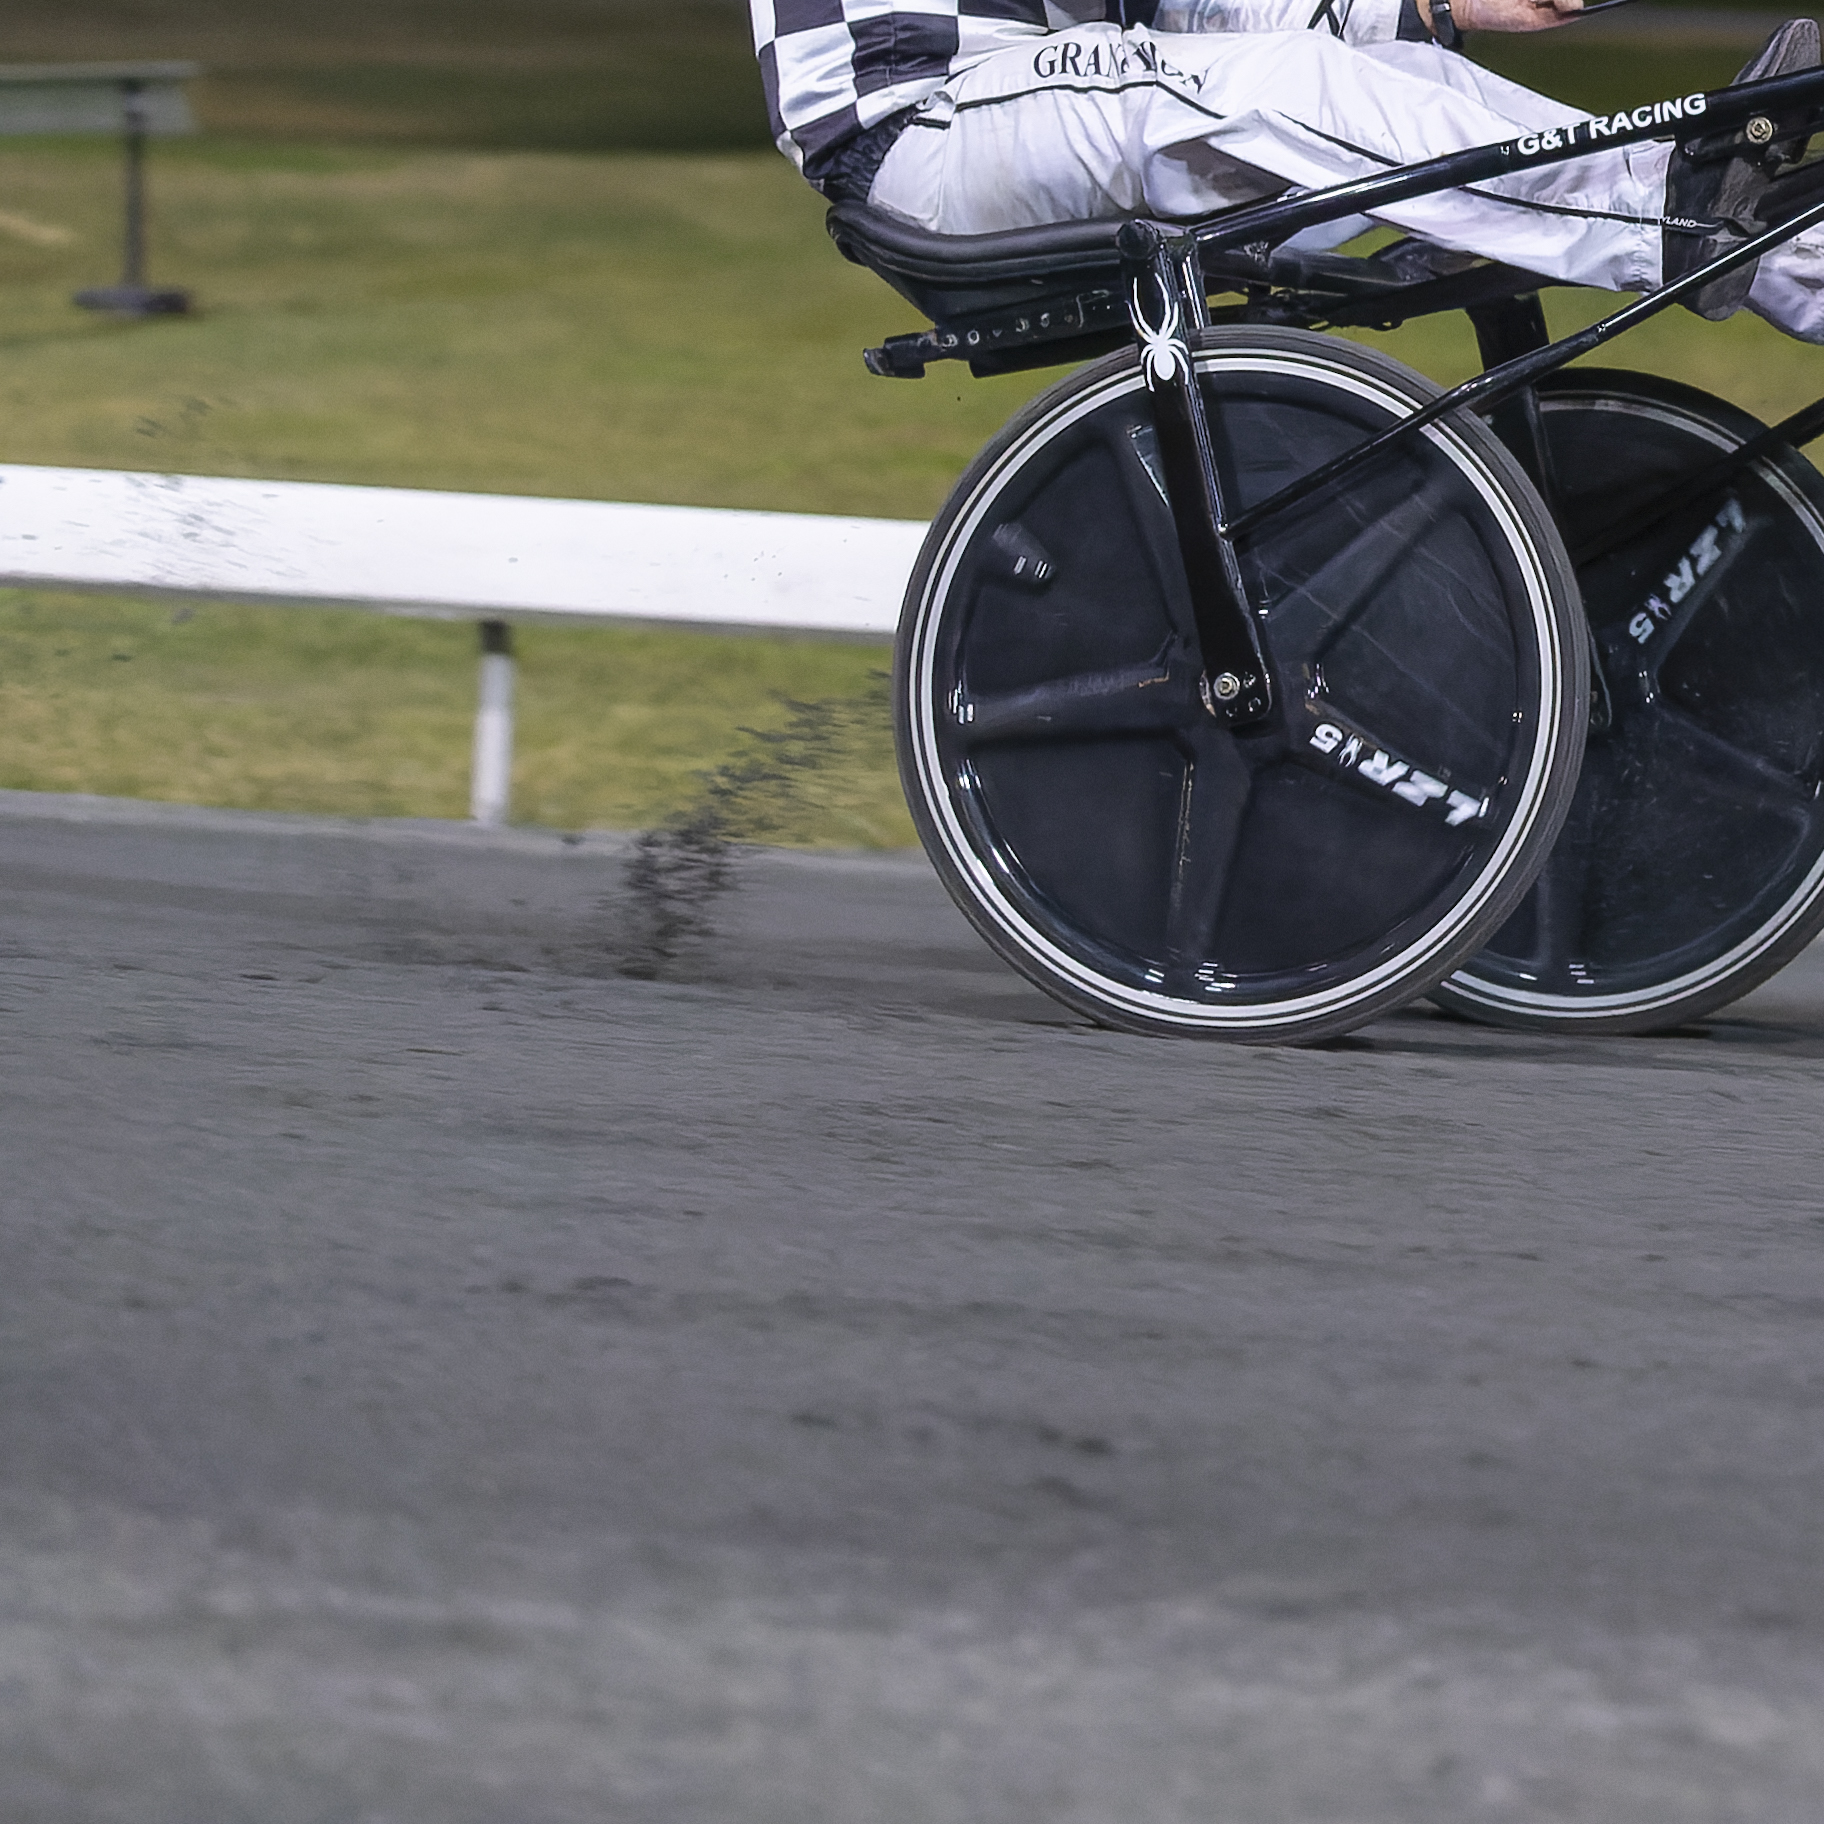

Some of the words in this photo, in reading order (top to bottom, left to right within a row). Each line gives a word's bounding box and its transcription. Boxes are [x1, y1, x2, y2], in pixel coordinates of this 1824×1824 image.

[1517, 123, 1581, 156] G&T
[1589, 93, 1707, 140] RACING
[1309, 724, 1343, 754] 5
[1358, 749, 1481, 826] LZR
